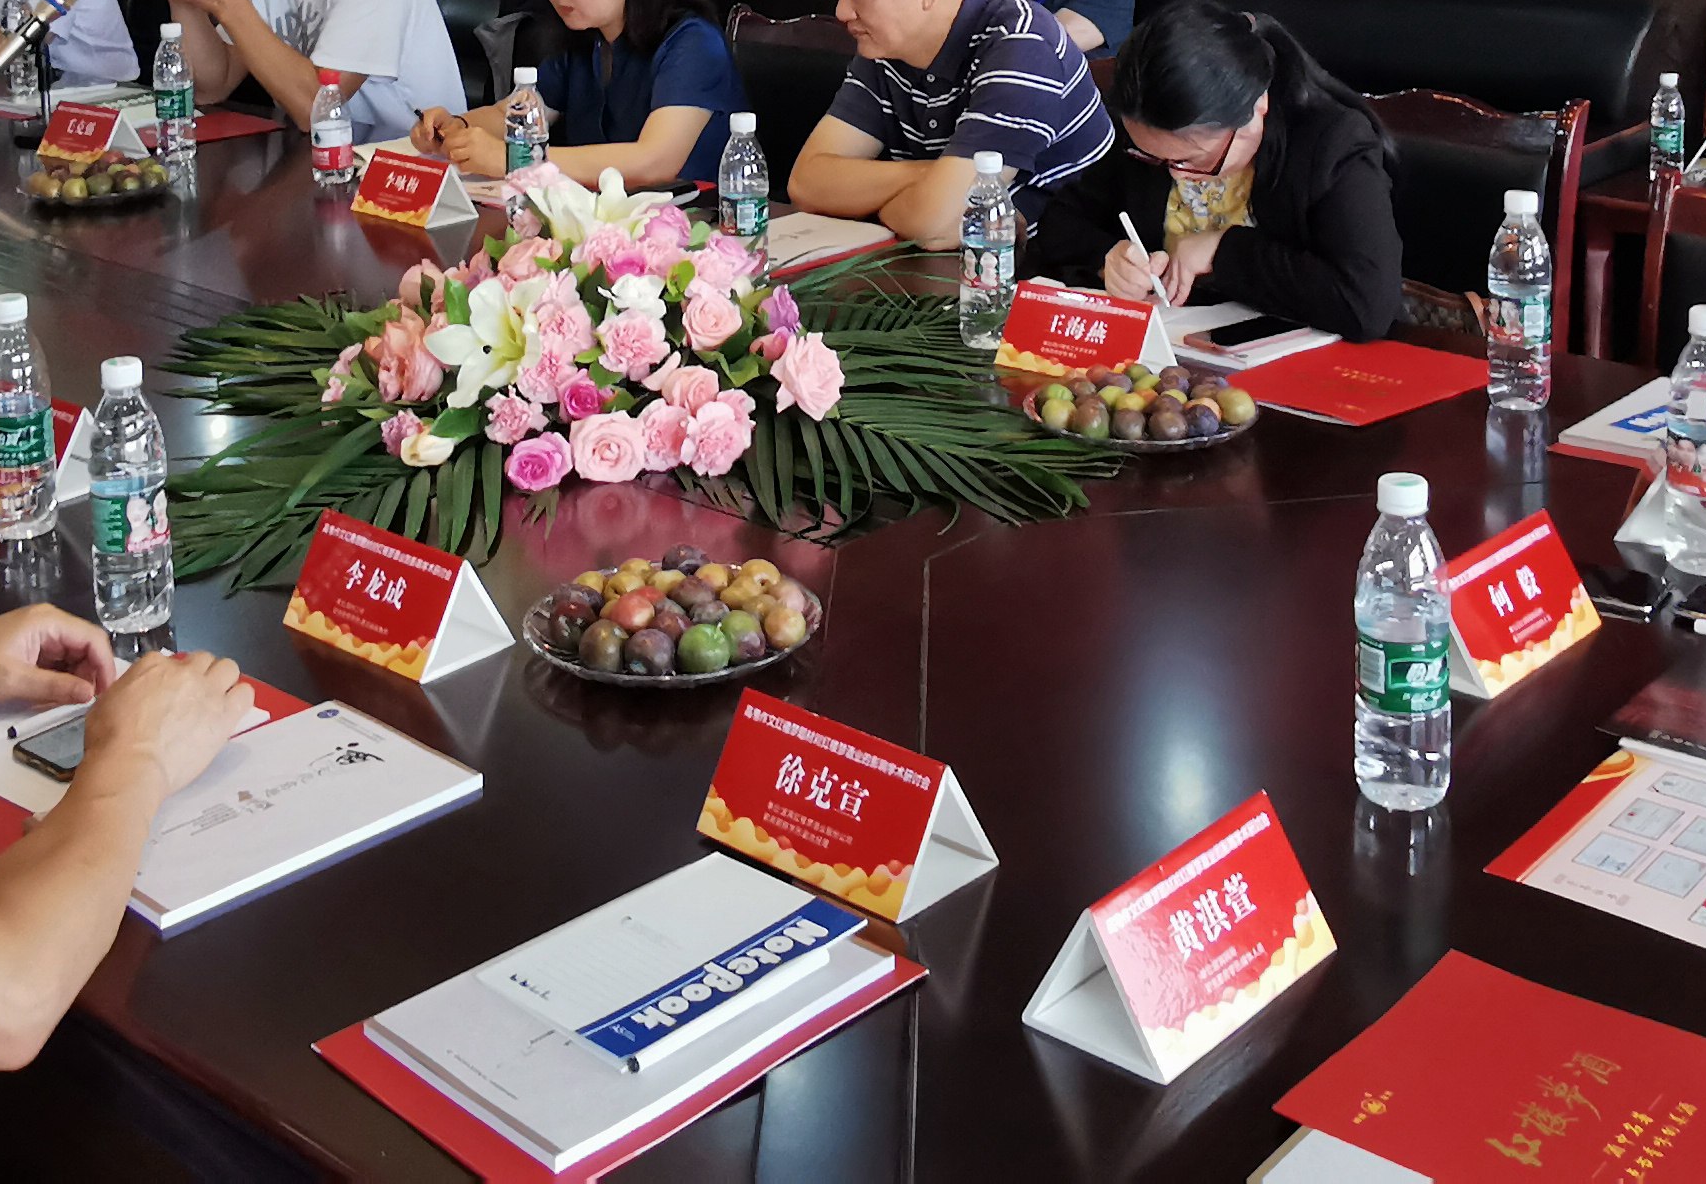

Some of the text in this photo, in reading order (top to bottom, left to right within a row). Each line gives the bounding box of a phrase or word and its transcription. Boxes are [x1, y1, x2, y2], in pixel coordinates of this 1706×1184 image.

[1049, 313, 1109, 345] 王海燕
[344, 558, 409, 611] 李龙成
[773, 752, 870, 822] 徐克宣
[1166, 871, 1259, 961] 黄淇萱
